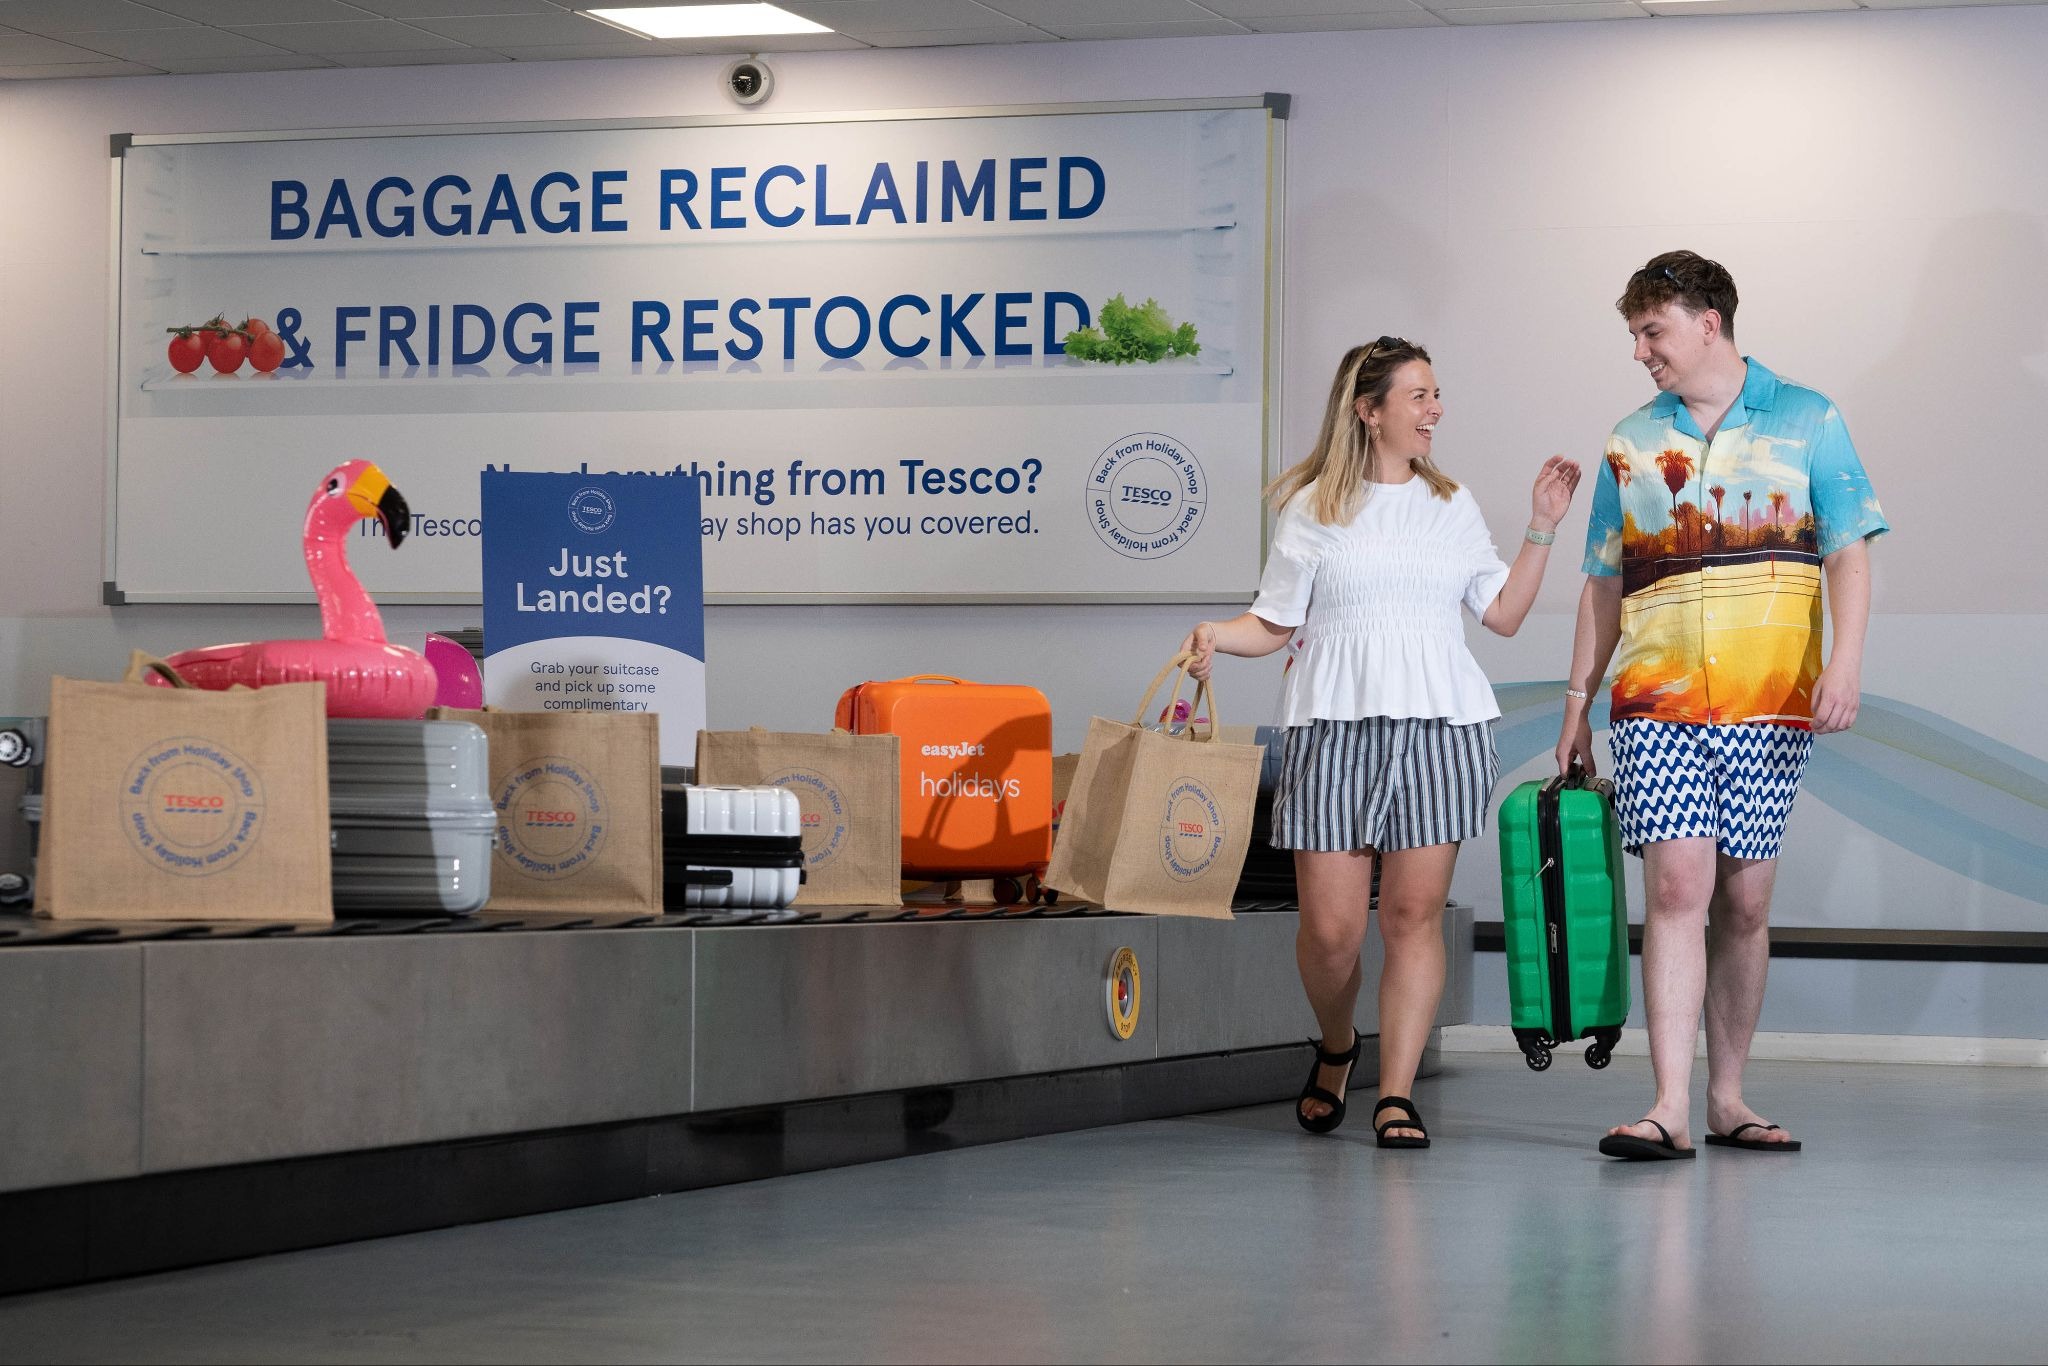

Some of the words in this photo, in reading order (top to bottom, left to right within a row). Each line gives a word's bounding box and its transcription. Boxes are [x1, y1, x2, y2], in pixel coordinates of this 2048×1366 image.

[270, 170, 628, 240] BAGGAGE
[659, 156, 1106, 230] RECLAIMED
[276, 307, 315, 368] &
[335, 301, 600, 367] FRIDGE
[631, 291, 1091, 363] RESTOCKED
[787, 460, 885, 496] from
[899, 457, 1043, 495] Tesco?
[1096, 458, 1117, 484] Back
[1116, 442, 1143, 459] from
[1146, 440, 1185, 465] Holiday
[1184, 464, 1198, 494] Shop
[1122, 486, 1172, 501] TESCO
[411, 513, 482, 537] Tesco
[736, 511, 801, 542] shop
[811, 511, 856, 535] has
[864, 516, 911, 541] you
[920, 510, 1039, 535] covered.
[1096, 500, 1110, 529] Shop
[1177, 507, 1198, 534] Back
[1109, 528, 1148, 552] Holiday
[1152, 532, 1179, 549] from
[549, 548, 628, 577] Just
[517, 582, 672, 615] Landed?
[530, 662, 564, 674] Grab
[568, 664, 599, 677] your
[603, 664, 660, 676] suitcase
[536, 680, 561, 692] and
[565, 680, 593, 694] pick
[598, 682, 614, 695] up
[618, 682, 656, 694] some
[544, 698, 648, 712] complimentary
[922, 742, 984, 759] easyJet
[128, 766, 151, 794] Back
[148, 748, 180, 766] from
[184, 745, 232, 769] Holiday
[233, 767, 254, 796] Shop
[496, 784, 518, 810] Back
[515, 767, 543, 784] from
[545, 764, 584, 785] Holiday
[583, 783, 600, 812] Shop
[791, 774, 828, 792] Holiday
[827, 790, 842, 814] Shop
[921, 771, 1020, 802] holidays
[164, 794, 224, 808] TESCO
[1166, 800, 1174, 822] Back
[1171, 785, 1185, 800] from
[1184, 783, 1208, 803] Holiday
[1207, 801, 1219, 826] Shop
[526, 811, 576, 822] TESCO
[1178, 822, 1203, 834] TESCO
[500, 826, 516, 855] Shop
[584, 825, 602, 852] Back
[832, 826, 845, 848] Back
[1210, 836, 1221, 859] Back
[515, 852, 556, 873] Holiday
[559, 852, 586, 870] from
[809, 848, 832, 864] from
[1170, 858, 1192, 876] Holiday
[1194, 860, 1210, 874] from
